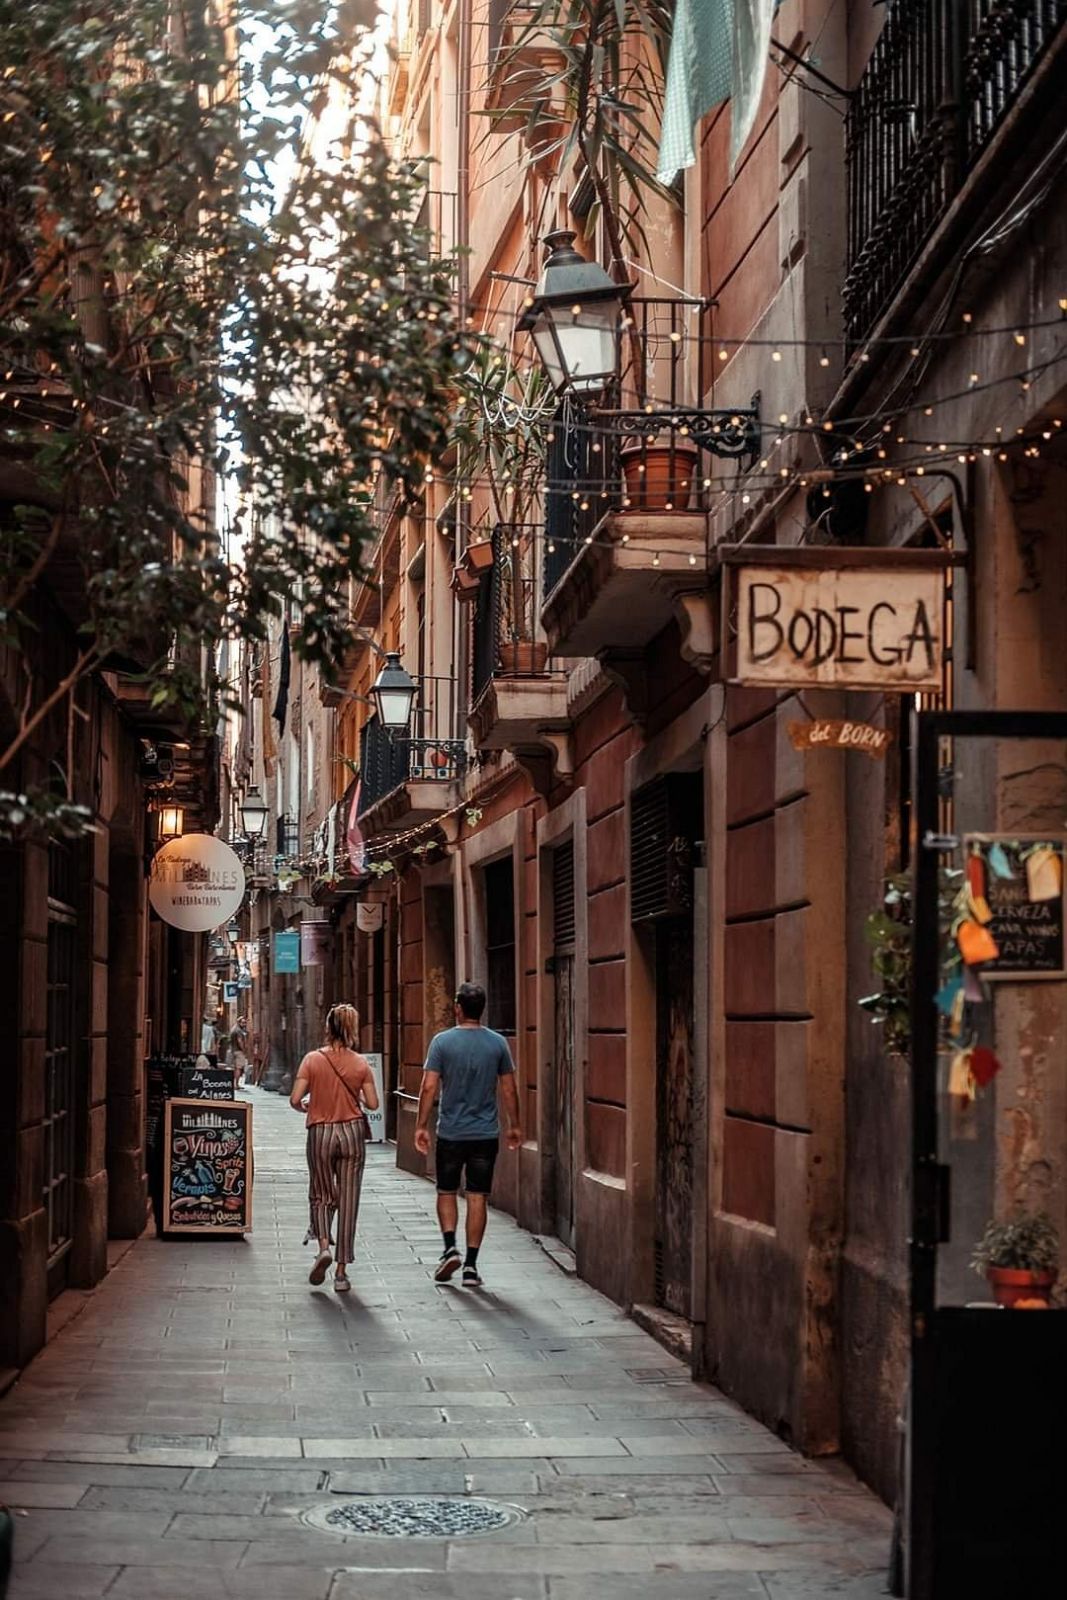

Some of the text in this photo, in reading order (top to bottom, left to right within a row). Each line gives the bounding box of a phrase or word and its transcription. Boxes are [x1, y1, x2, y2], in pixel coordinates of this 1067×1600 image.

[748, 583, 938, 670] BODEGA
[809, 722, 885, 747] del BORN
[187, 1135, 229, 1159] Vinos
[215, 1157, 245, 1169] Spritz
